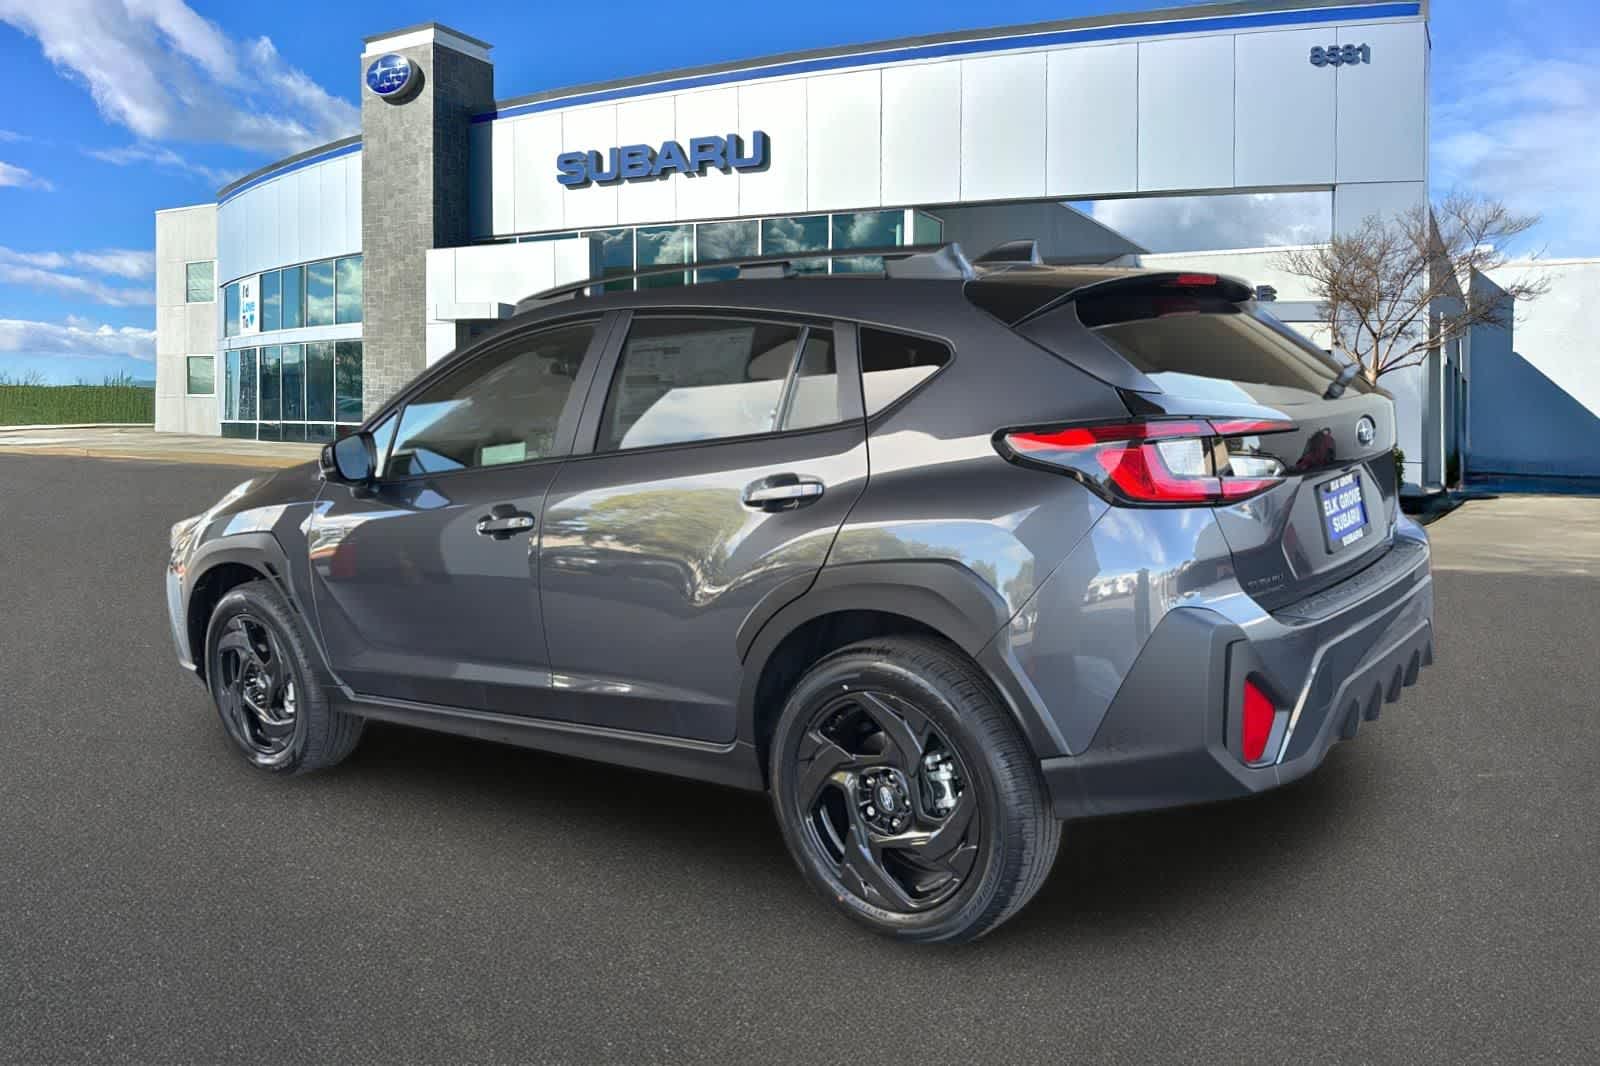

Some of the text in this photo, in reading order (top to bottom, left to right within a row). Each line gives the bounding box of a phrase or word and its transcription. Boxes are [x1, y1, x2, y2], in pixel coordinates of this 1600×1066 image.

[556, 130, 771, 190] SUBARU
[242, 301, 256, 313] Love
[1324, 487, 1361, 517] ELK GROVE
[1332, 507, 1361, 533] SUBARU
